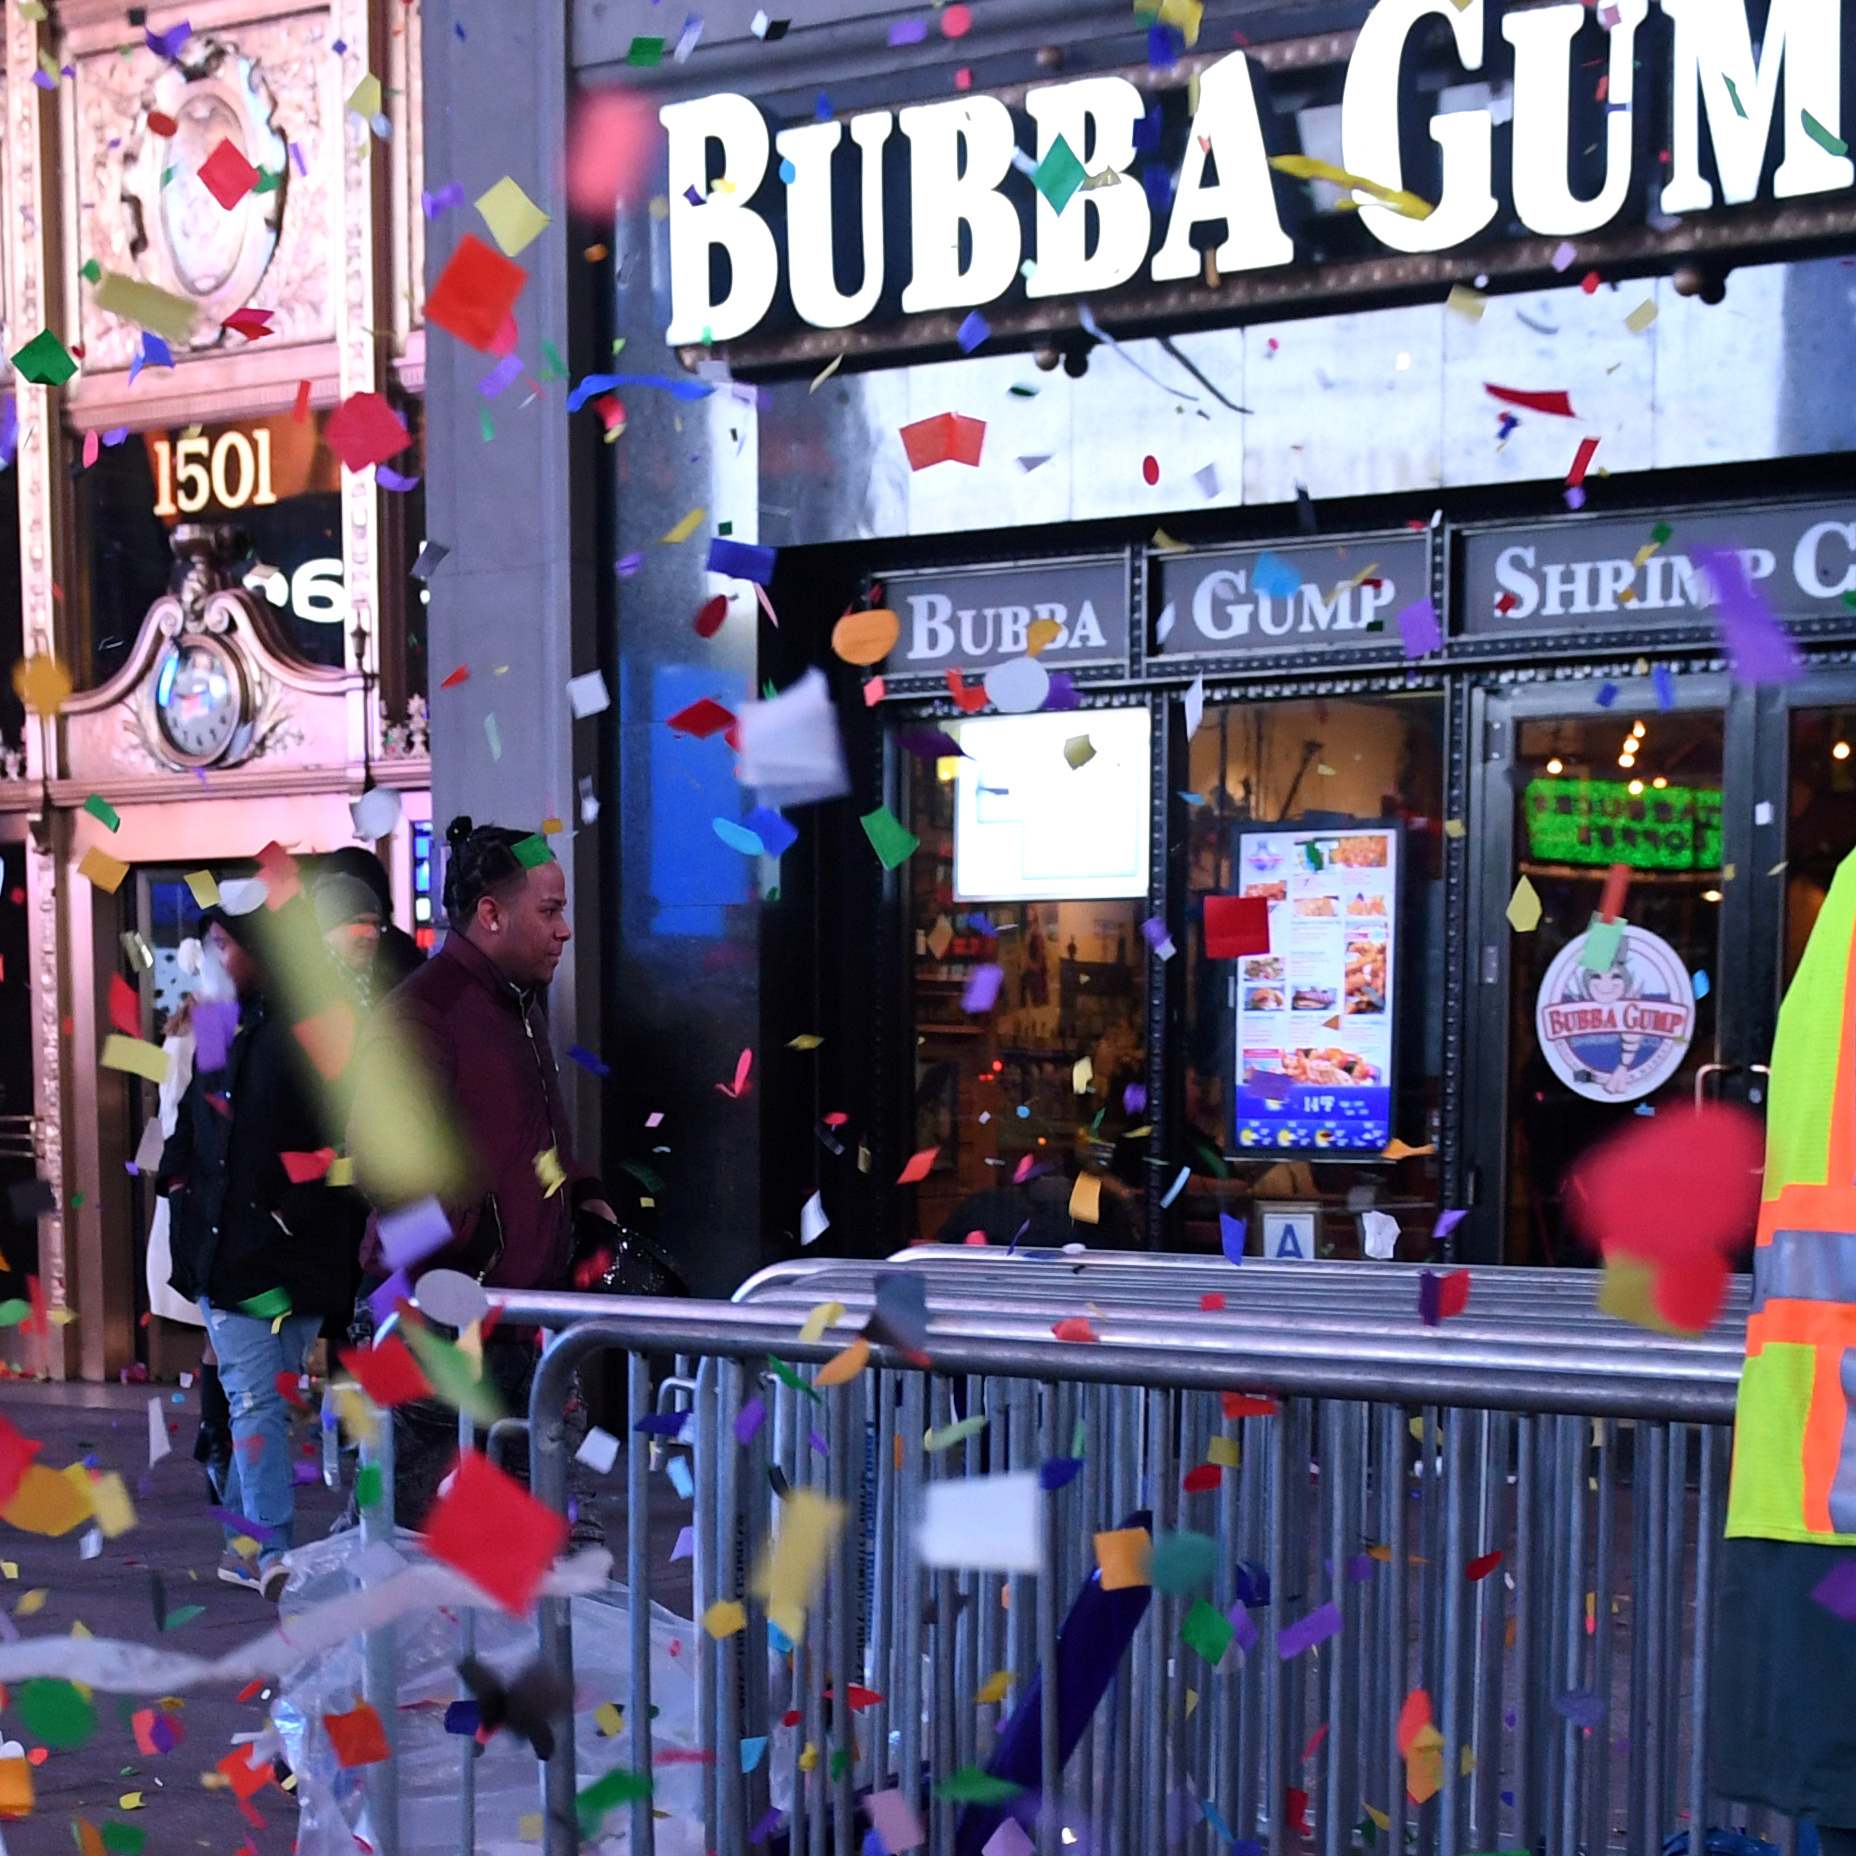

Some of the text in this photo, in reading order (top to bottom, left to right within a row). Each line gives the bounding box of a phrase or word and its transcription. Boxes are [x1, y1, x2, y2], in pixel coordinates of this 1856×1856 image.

[660, 49, 1293, 346] BUBBA
[153, 427, 277, 517] 1501
[906, 592, 1107, 661] BUBBA
[1191, 568, 1397, 645] GUMP
[1549, 1003, 1685, 1035] BUBBA GUMP
[1277, 1224, 1303, 1258] A
